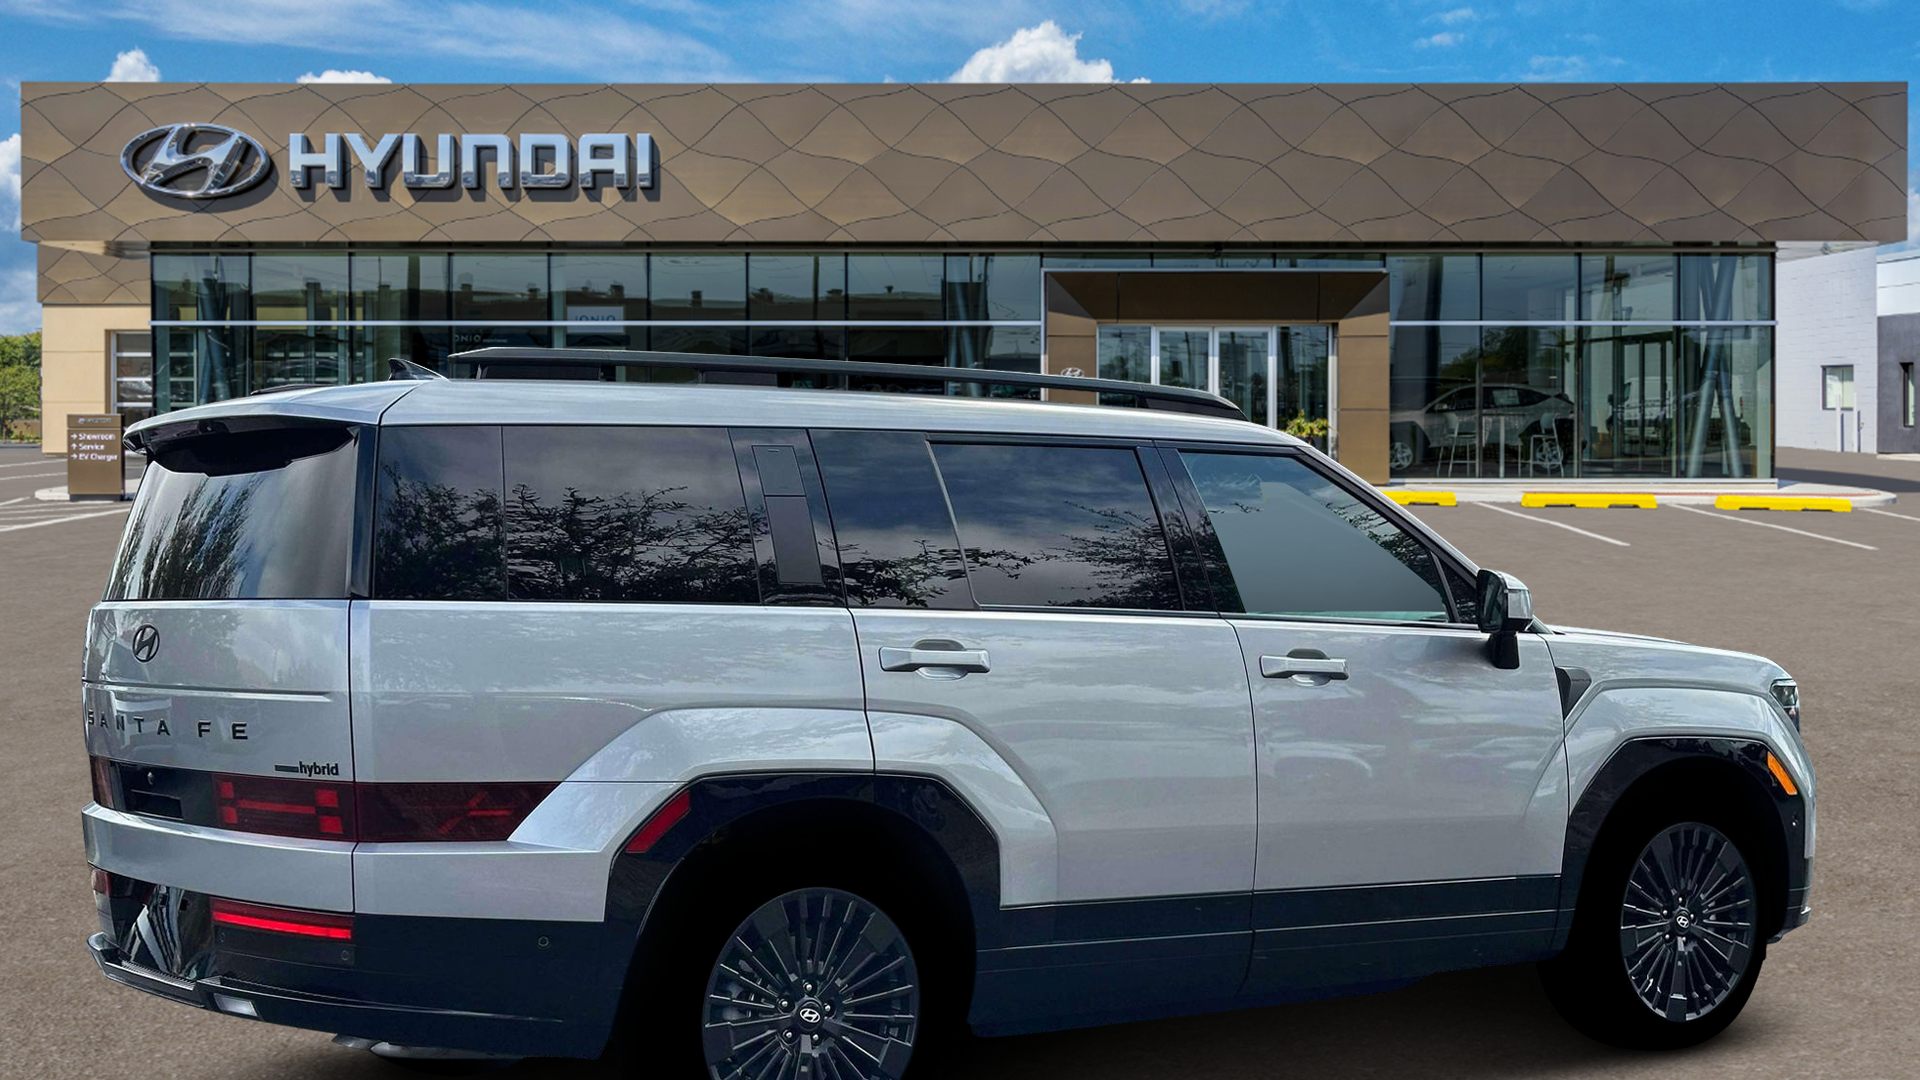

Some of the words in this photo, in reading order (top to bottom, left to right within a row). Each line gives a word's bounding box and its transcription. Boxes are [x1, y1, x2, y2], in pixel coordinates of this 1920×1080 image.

[289, 133, 653, 189] HYUNDAI
[78, 432, 116, 441] Showroom
[78, 442, 106, 451] Service
[78, 453, 90, 461] EV
[90, 453, 119, 462] Charger
[87, 709, 171, 737] SANTA
[197, 719, 249, 741] FE
[299, 760, 340, 778] hybrid
